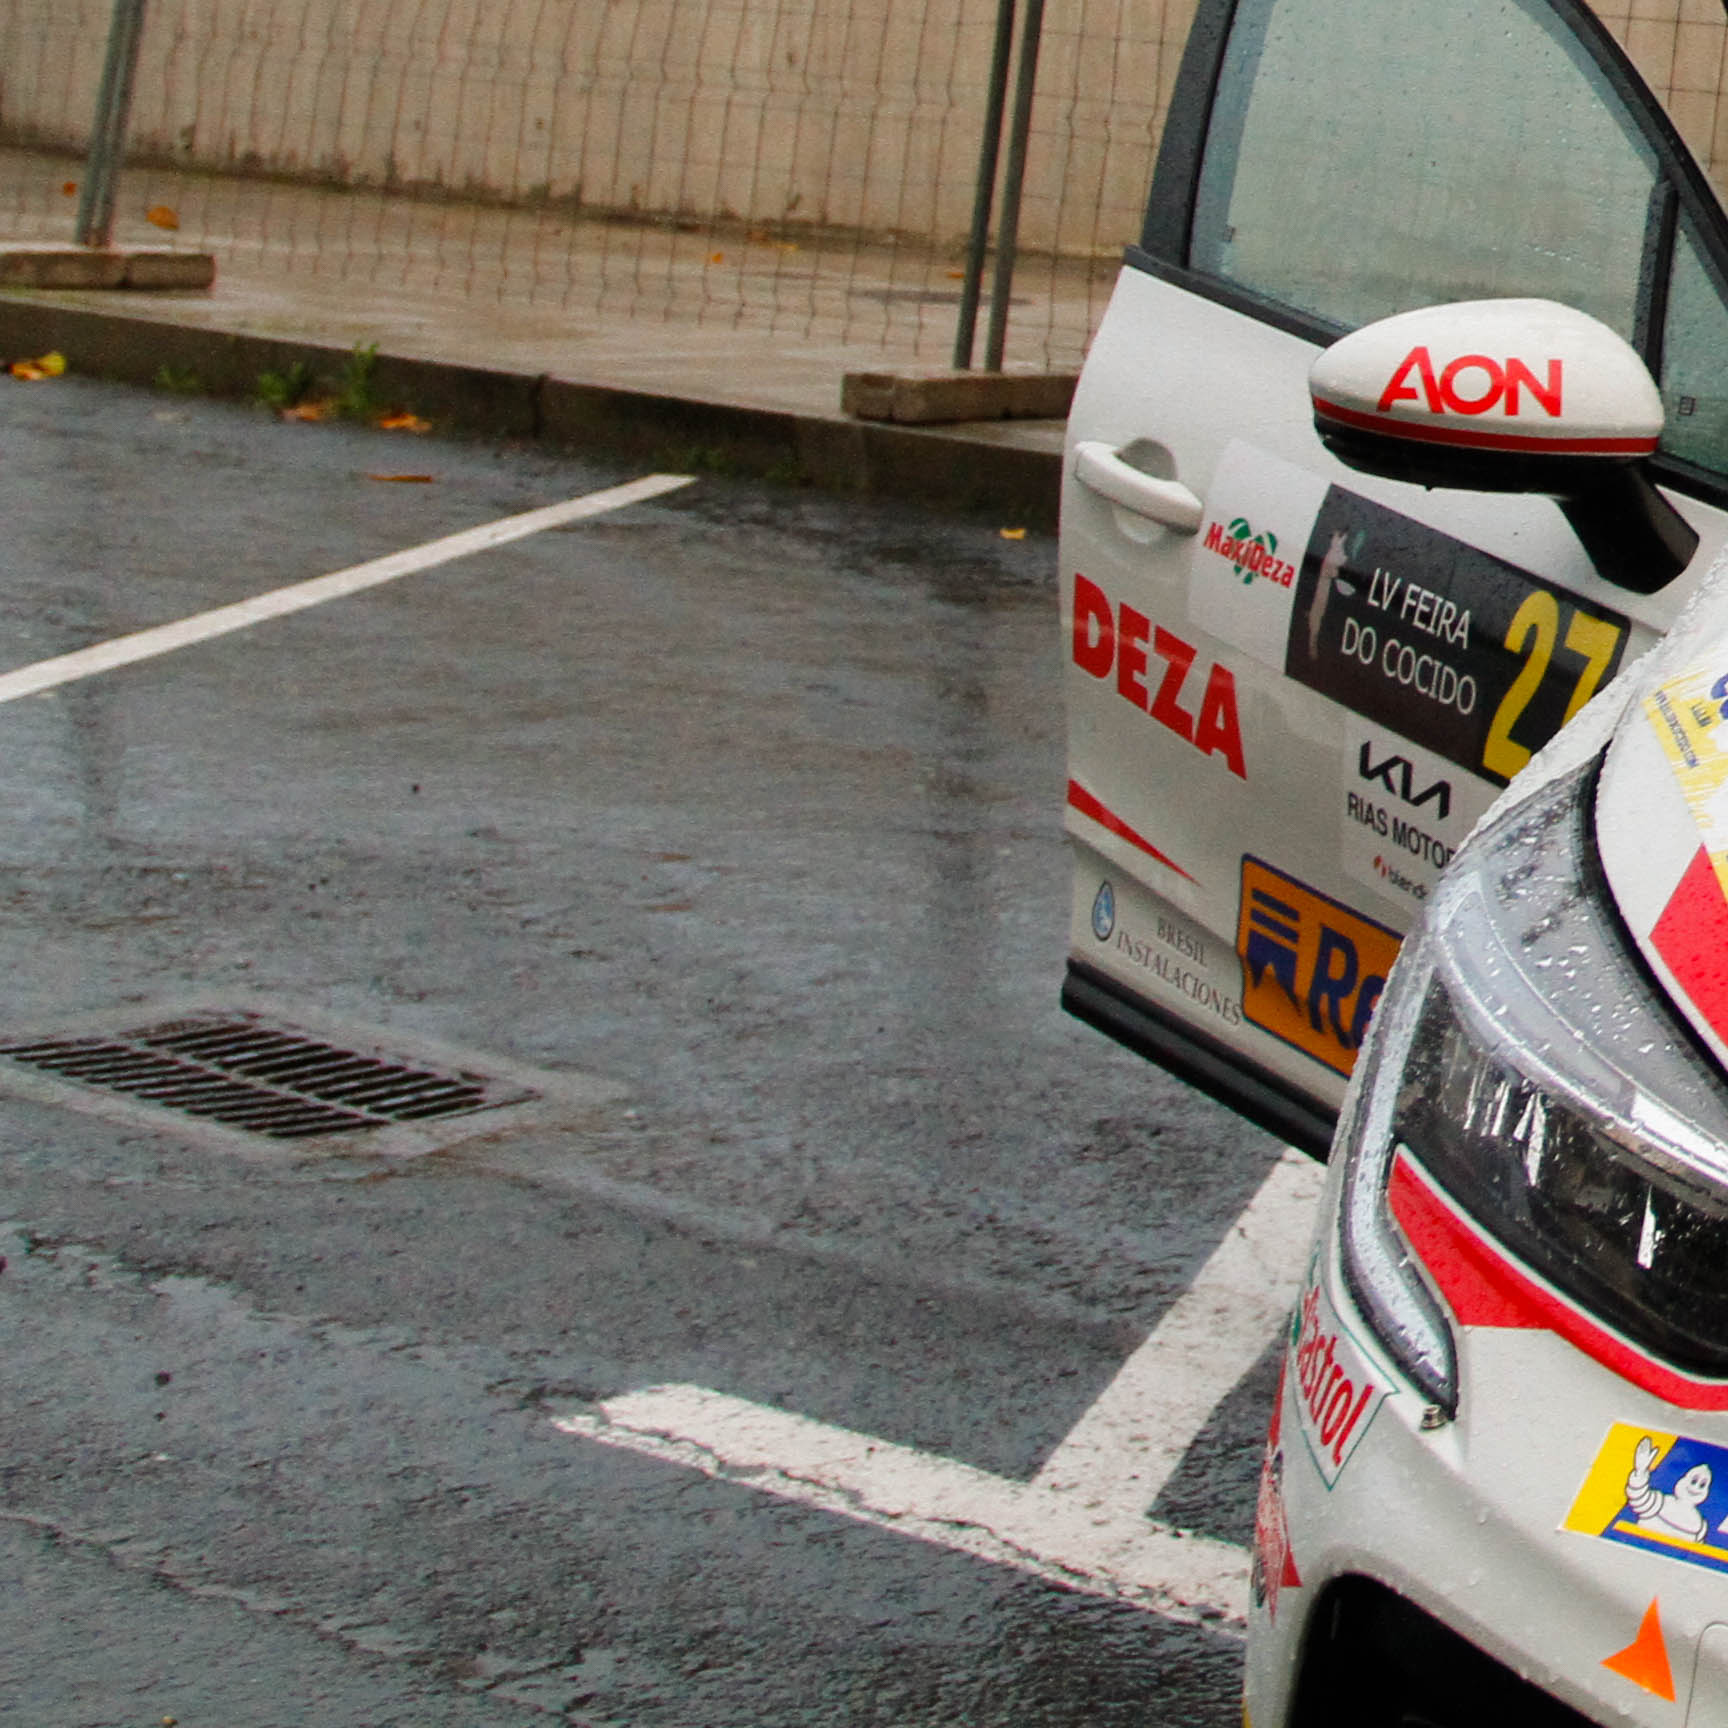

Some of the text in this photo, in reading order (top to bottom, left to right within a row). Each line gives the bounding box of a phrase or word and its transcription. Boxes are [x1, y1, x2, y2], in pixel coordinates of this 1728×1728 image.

[1375, 345, 1563, 418] AON
[1202, 521, 1296, 589] MaxiDeza
[1366, 567, 1472, 650] LV FEIRA
[1072, 572, 1248, 781] DEZA
[1341, 617, 1476, 715] DO COCIDO
[1482, 590, 1622, 780] 27
[1348, 791, 1389, 838] RIAS
[1116, 930, 1242, 1027] INSTALACIONES
[1157, 918, 1208, 968] BRESIL
